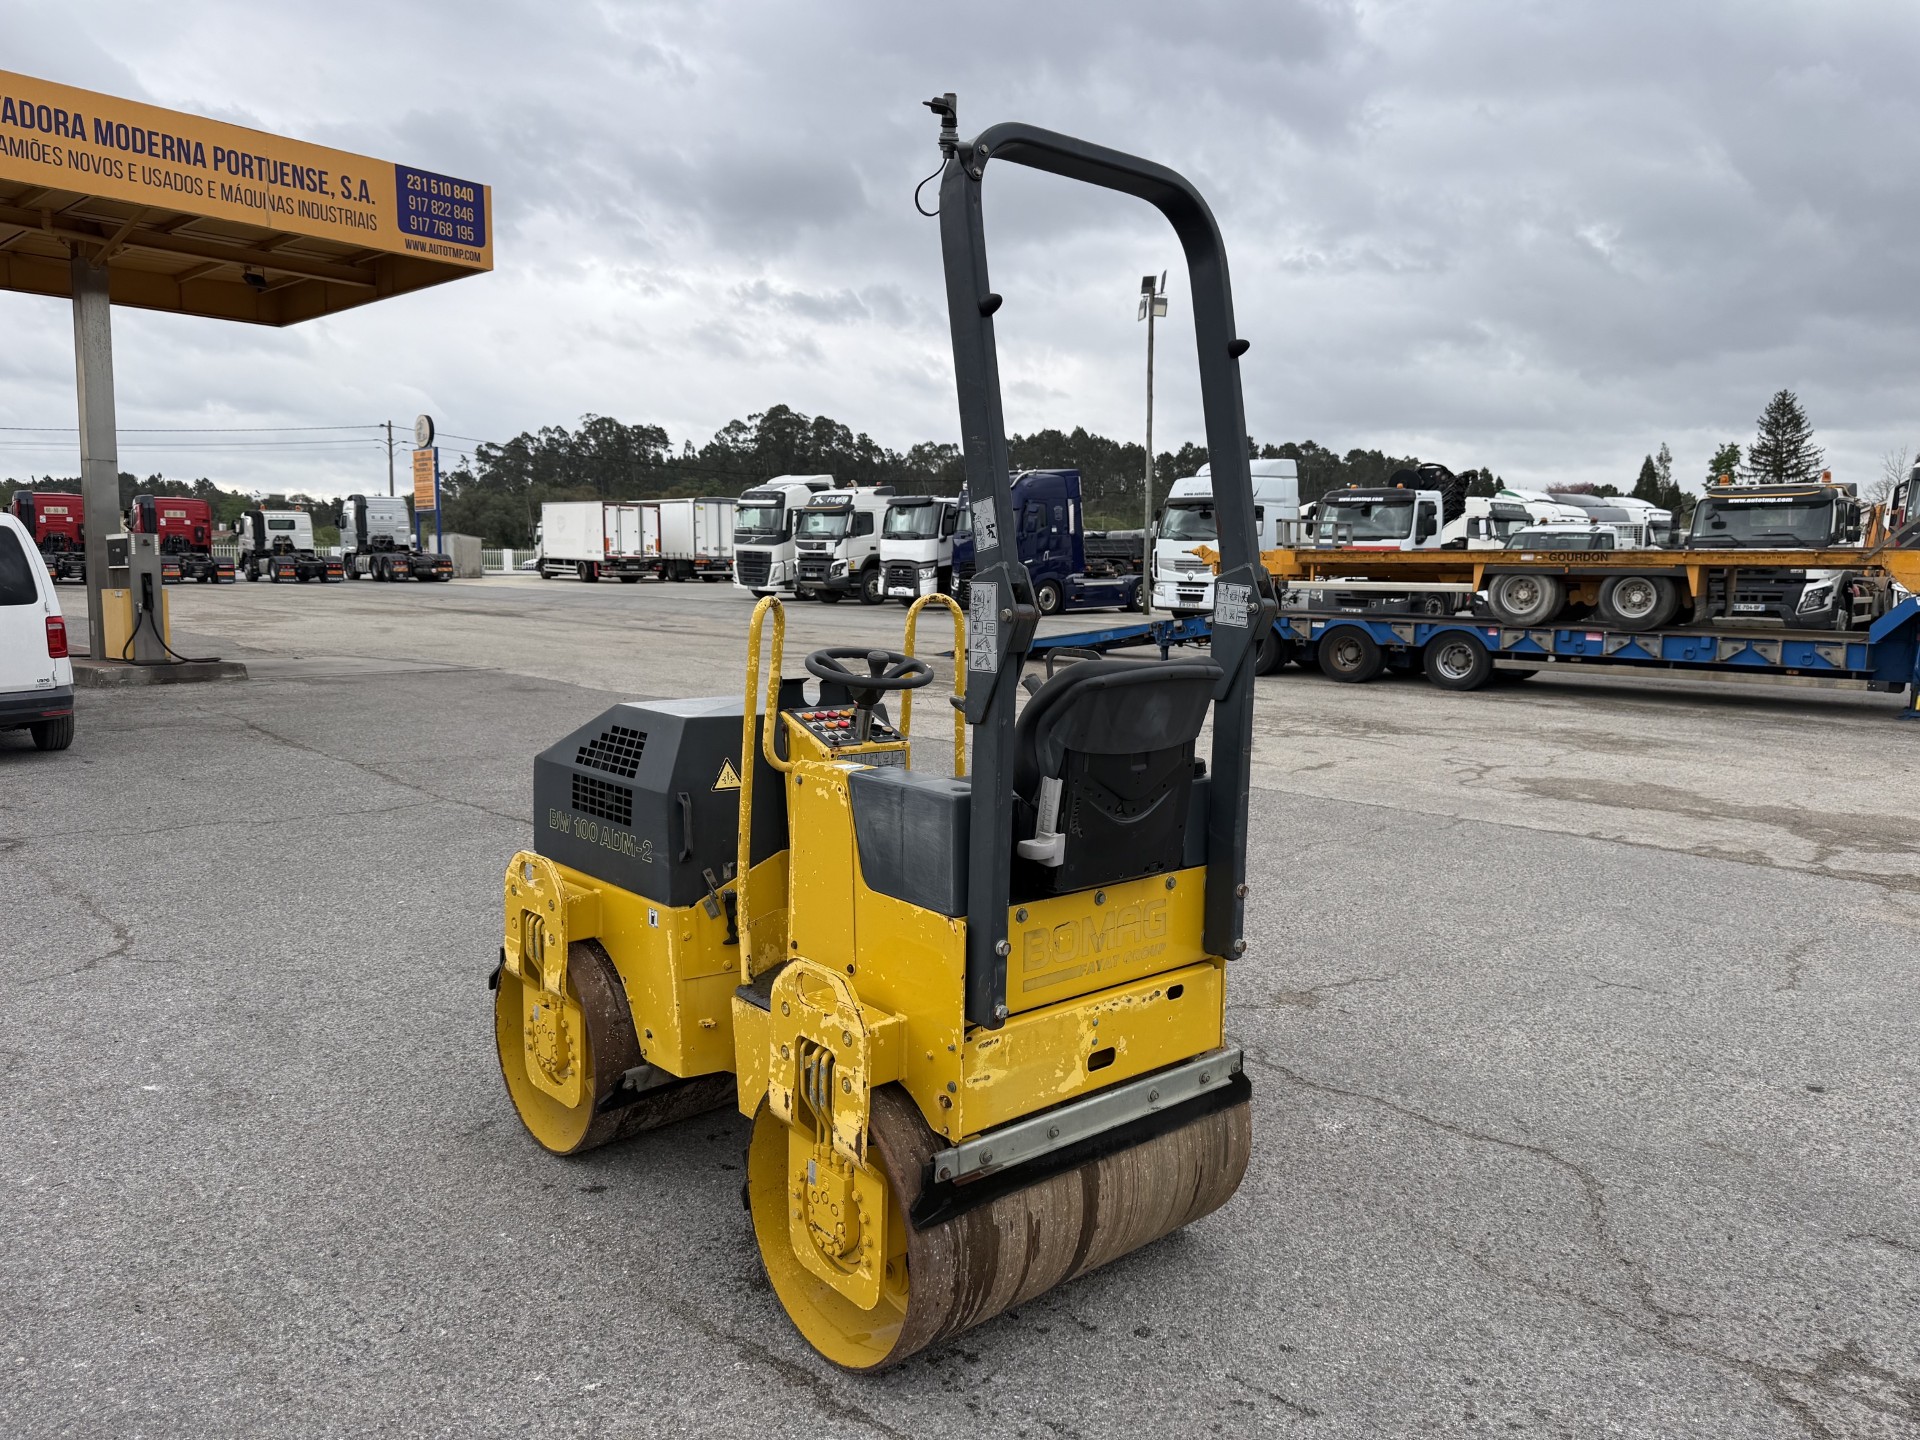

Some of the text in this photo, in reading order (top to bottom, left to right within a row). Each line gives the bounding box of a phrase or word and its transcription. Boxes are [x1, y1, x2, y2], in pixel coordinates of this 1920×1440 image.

[0, 95, 376, 205] ADORA MODERNA PORTUENSE, S.A.
[68, 149, 124, 179] NOVOS
[128, 162, 138, 182] E
[142, 165, 204, 196] USADOS
[207, 180, 217, 199] E
[220, 182, 295, 215] MÁQUINAS
[298, 199, 377, 231] INDUSTRIAIS
[406, 174, 474, 202] 231 510 840
[408, 195, 474, 222] 917 822 846
[410, 215, 475, 241] 917 768 195
[404, 238, 481, 263] WWW.AUTOTMP.COM
[1548, 551, 1608, 562] GOURDON
[549, 808, 653, 863] BW 100 ADM-2
[1022, 898, 1167, 974] BOMAG
[1122, 942, 1167, 965] GROUP
